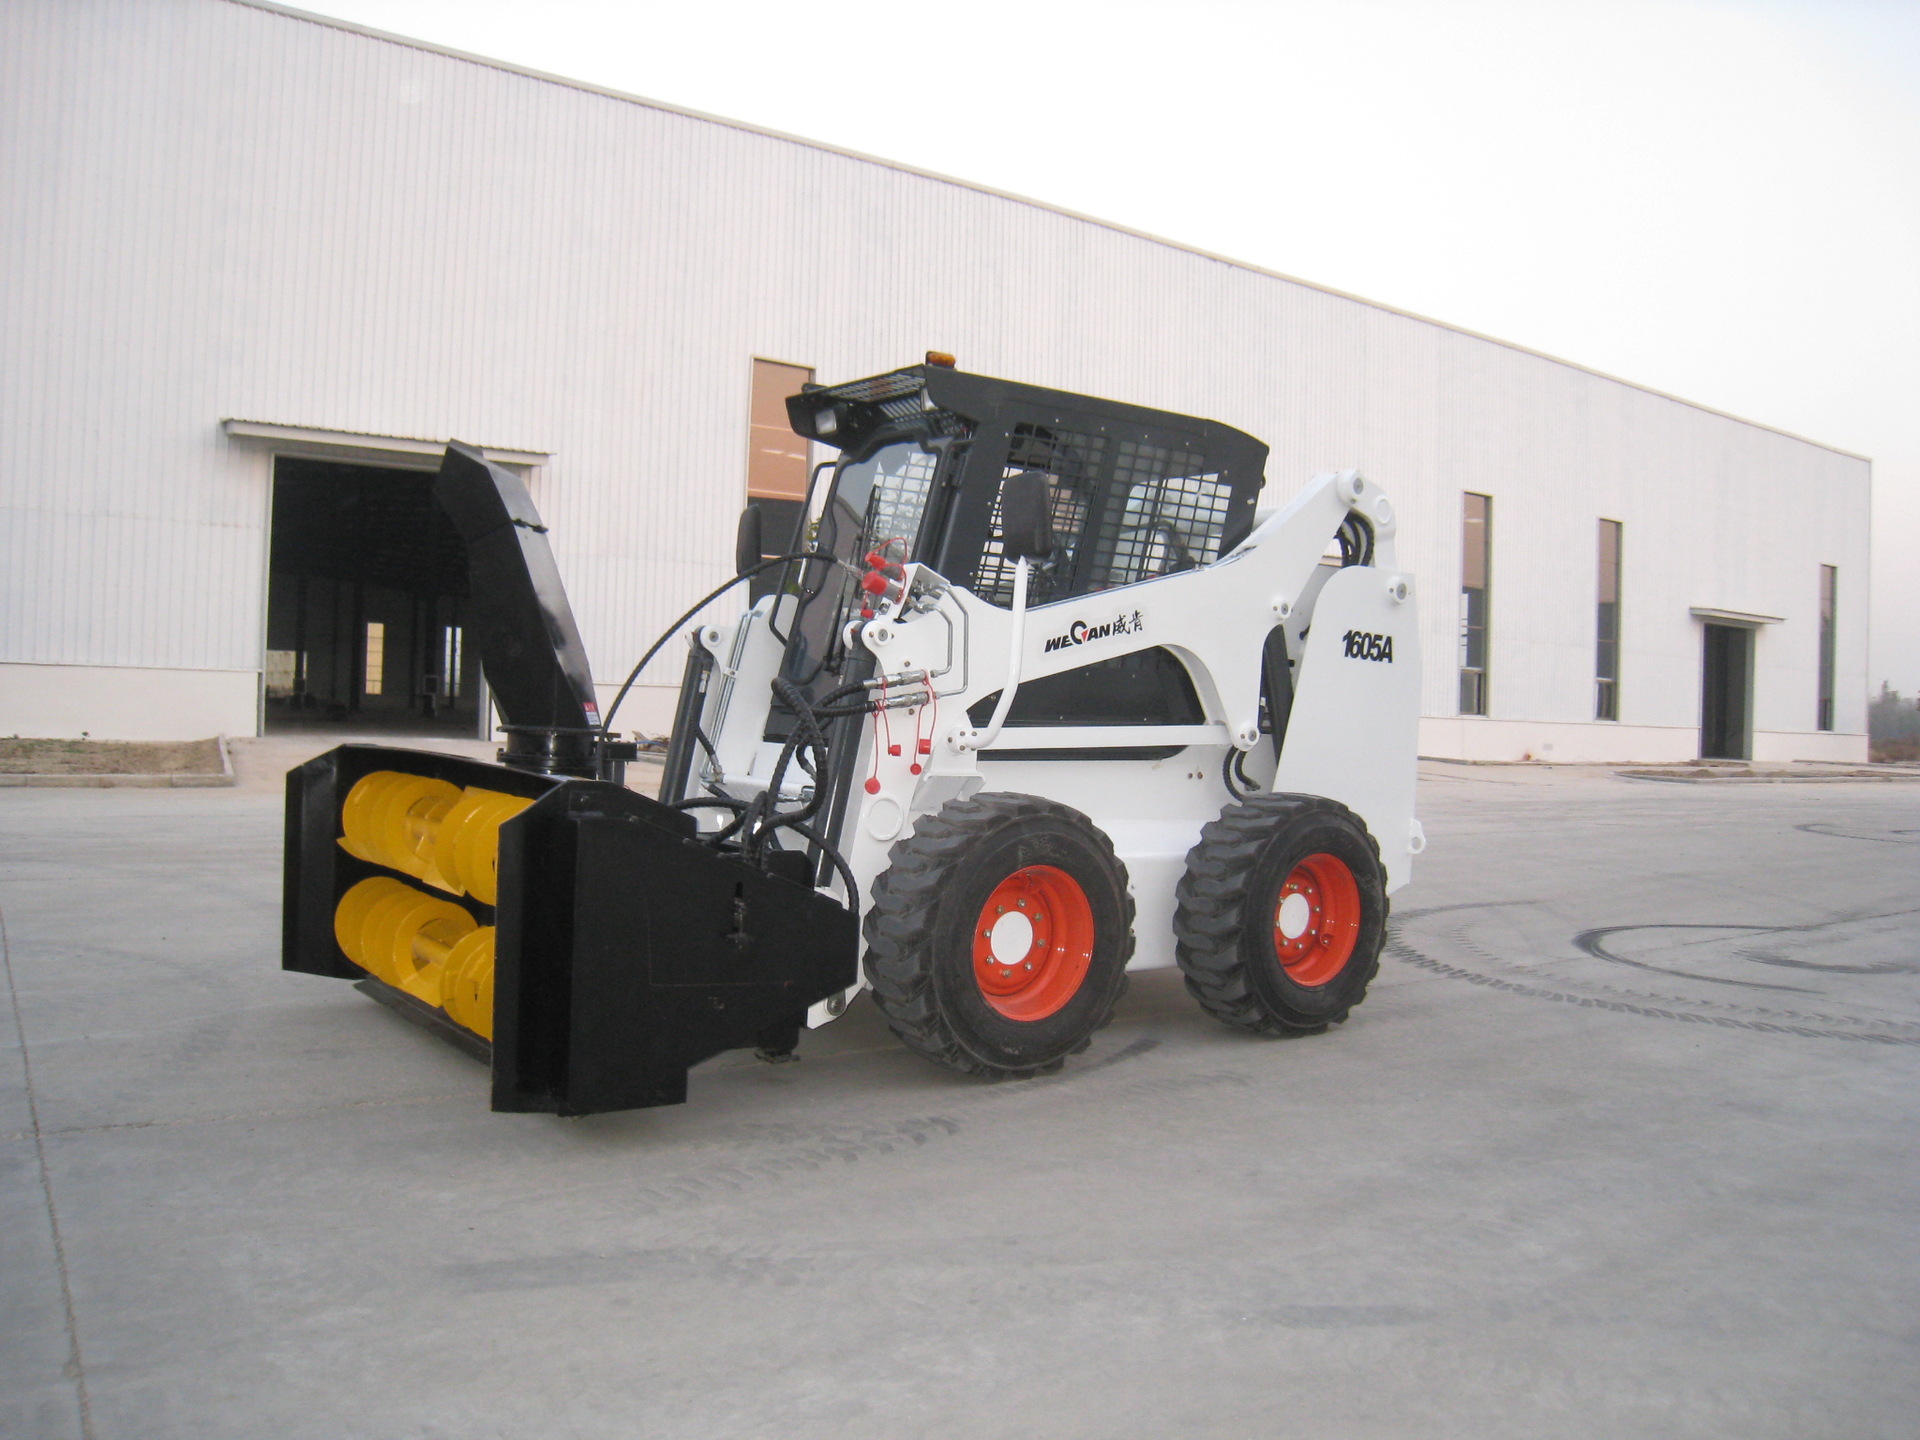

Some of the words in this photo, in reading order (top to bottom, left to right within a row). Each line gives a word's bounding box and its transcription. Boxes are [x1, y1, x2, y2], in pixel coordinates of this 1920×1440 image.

[1044, 620, 1110, 653] WECAN
[1112, 610, 1144, 636] 威肯
[1342, 629, 1393, 663] 1605A
